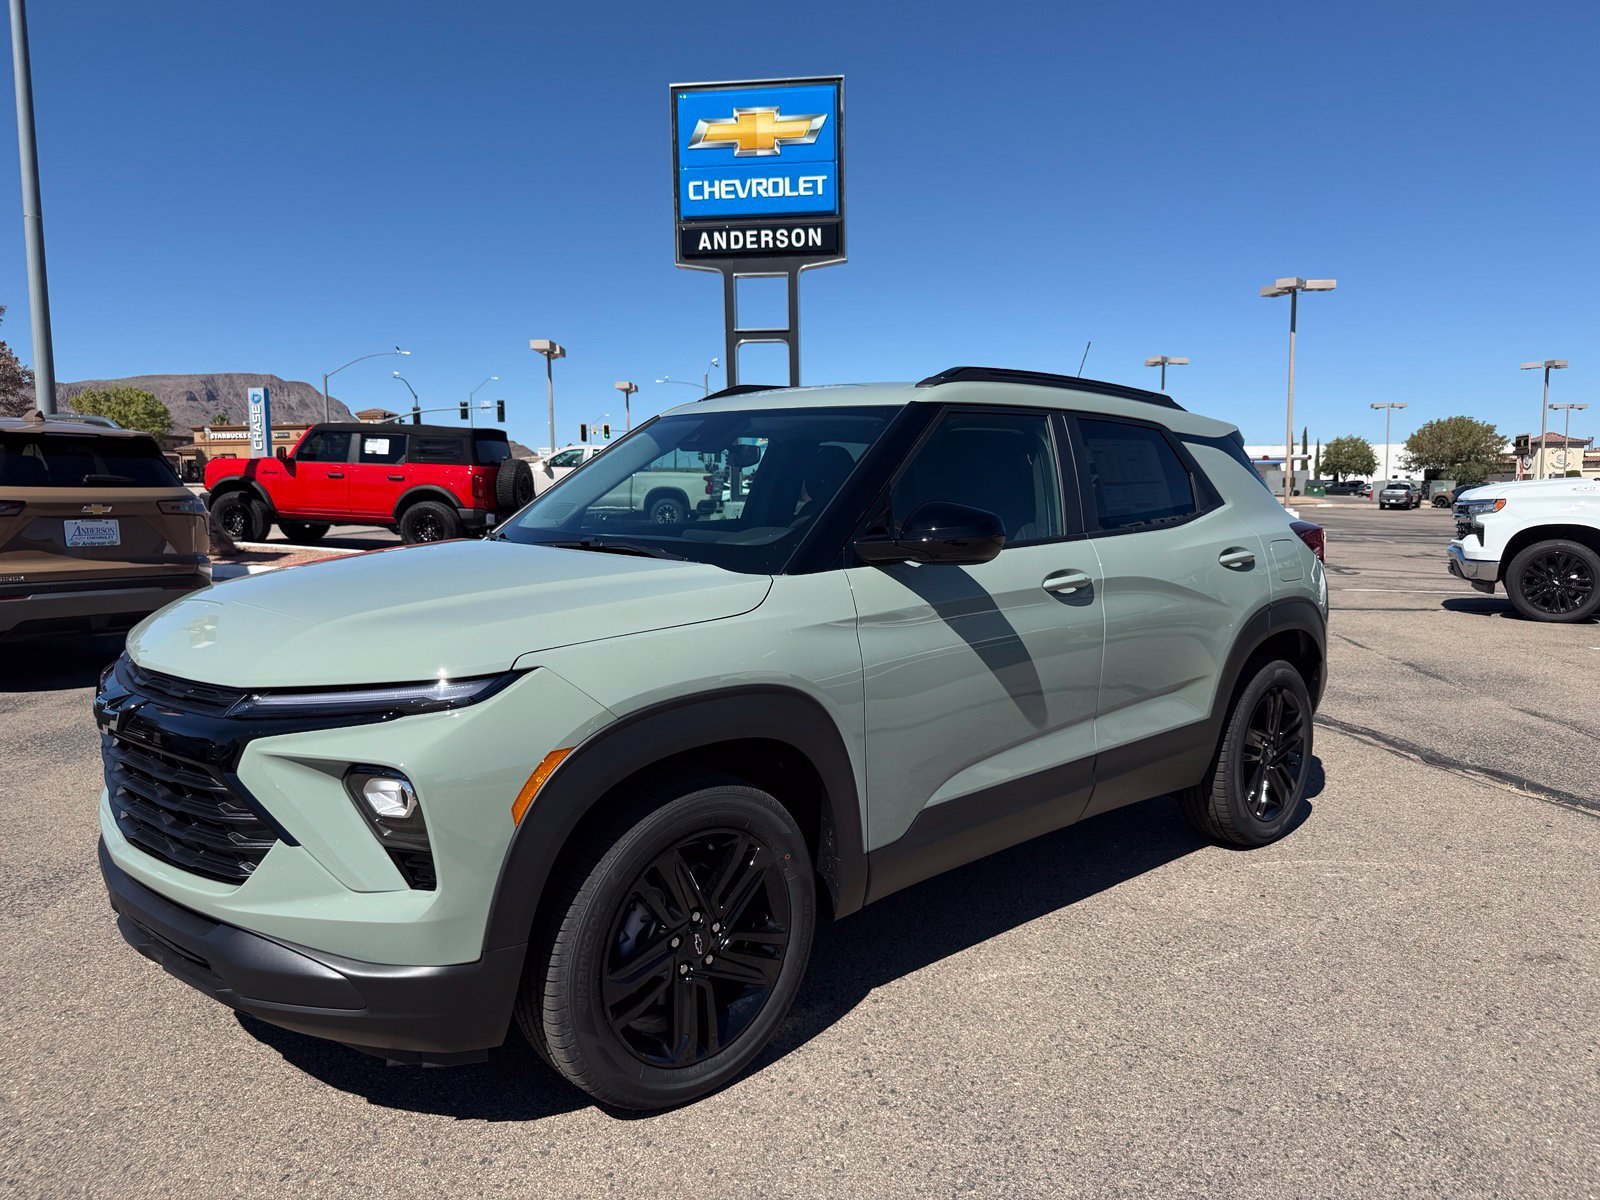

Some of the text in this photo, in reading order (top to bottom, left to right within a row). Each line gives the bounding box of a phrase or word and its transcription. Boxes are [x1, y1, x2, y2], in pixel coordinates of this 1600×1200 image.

[688, 175, 828, 200] CHEVROLET
[698, 227, 822, 251] ANDERSON
[210, 432, 248, 440] STARBUCKS
[252, 405, 263, 451] CHASE
[70, 526, 115, 540] ANDERSON
